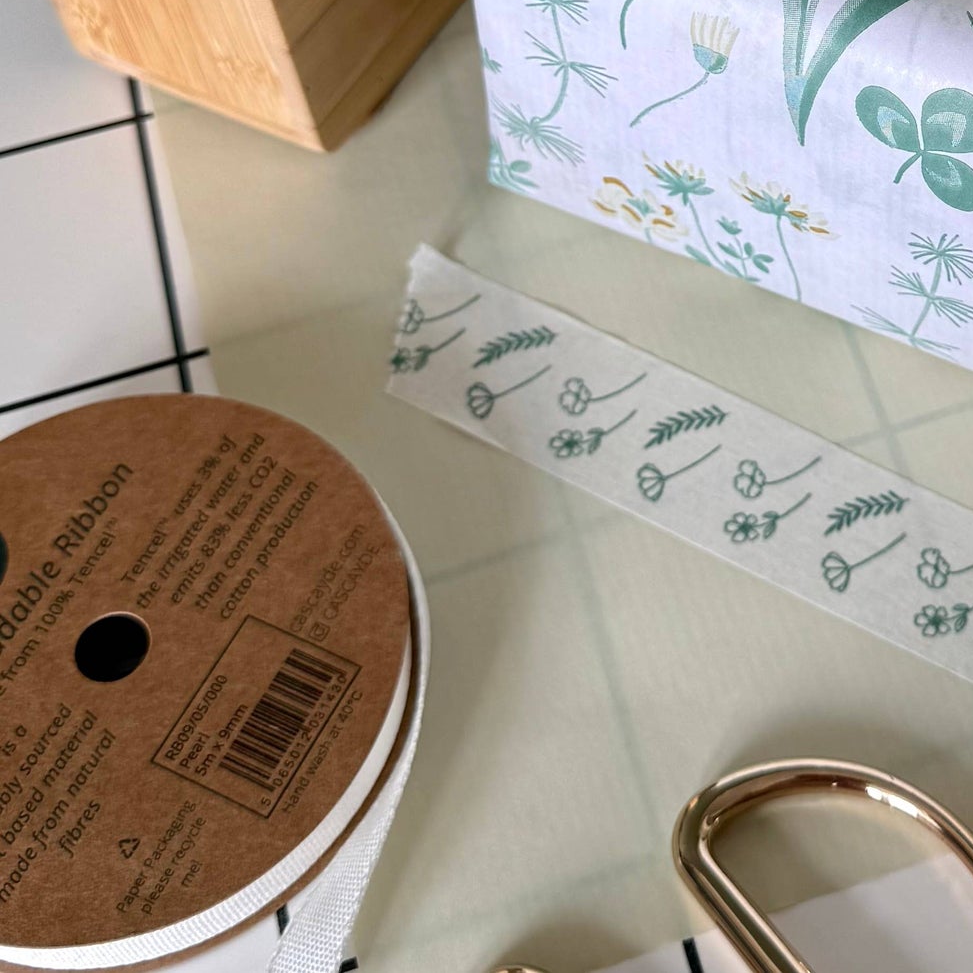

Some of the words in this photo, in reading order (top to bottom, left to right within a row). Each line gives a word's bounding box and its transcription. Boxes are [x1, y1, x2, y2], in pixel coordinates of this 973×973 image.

[173, 481, 202, 516] uses
[197, 455, 221, 480] 3%
[219, 434, 238, 454] of
[0, 559, 62, 656] dable
[53, 462, 134, 558] Ribbon
[136, 580, 162, 609] the
[158, 509, 209, 580] irrigated
[206, 465, 242, 510] water
[239, 432, 265, 465] and
[171, 559, 206, 605] emits
[201, 523, 231, 558] 83%
[225, 492, 253, 521] less
[249, 455, 278, 489] CO2
[194, 570, 227, 609] than
[224, 468, 297, 569] conventional
[220, 567, 260, 619] cotton
[256, 479, 319, 569] production
[1, 637, 40, 683] from
[35, 589, 76, 633] 100%
[2, 740, 17, 758] is
[14, 724, 28, 738] a
[19, 702, 73, 776] sourced
[165, 674, 228, 762] RB09/05/000
[179, 732, 211, 770] Pearl
[212, 740, 226, 753] x
[218, 703, 250, 741] 9mm
[1, 786, 45, 845] based
[42, 709, 99, 788] material
[194, 751, 218, 778] 5m
[282, 774, 312, 814] Hand
[307, 739, 335, 778] wash
[329, 725, 345, 740] at
[0, 847, 38, 903] made
[31, 798, 71, 851] from
[66, 728, 118, 798] natural
[57, 799, 101, 859] fibres
[115, 871, 148, 914] Paper
[143, 800, 197, 869] Packaging
[140, 867, 175, 916] please
[171, 817, 207, 866] recycle
[181, 859, 203, 888] me!
